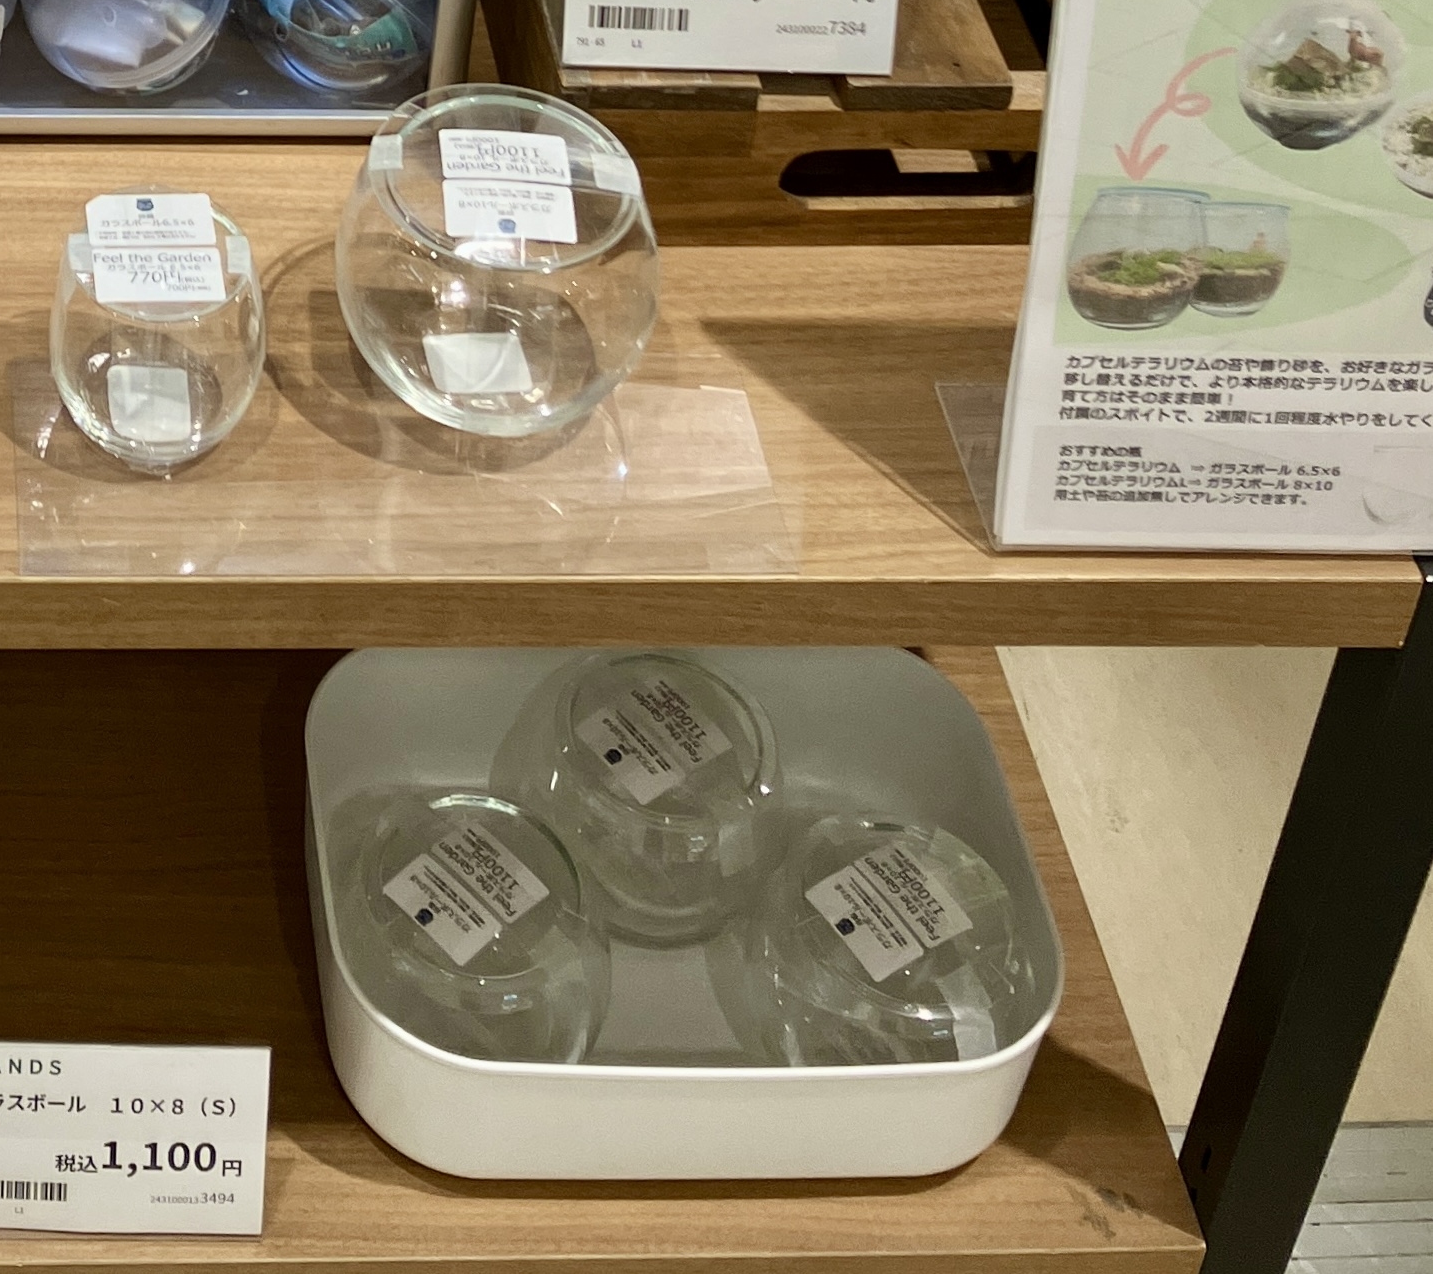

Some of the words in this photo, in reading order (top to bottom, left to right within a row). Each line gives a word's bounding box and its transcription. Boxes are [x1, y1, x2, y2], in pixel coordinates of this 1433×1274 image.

[94, 253, 122, 263] Feel
[129, 253, 152, 263] the
[158, 253, 212, 263] Garden
[128, 271, 182, 283] 770円
[1057, 460, 1180, 475] カプセルテラリウム
[1294, 480, 1333, 492] 8×10
[864, 857, 900, 894] Garden
[900, 894, 918, 915] the
[916, 915, 940, 941] Feel
